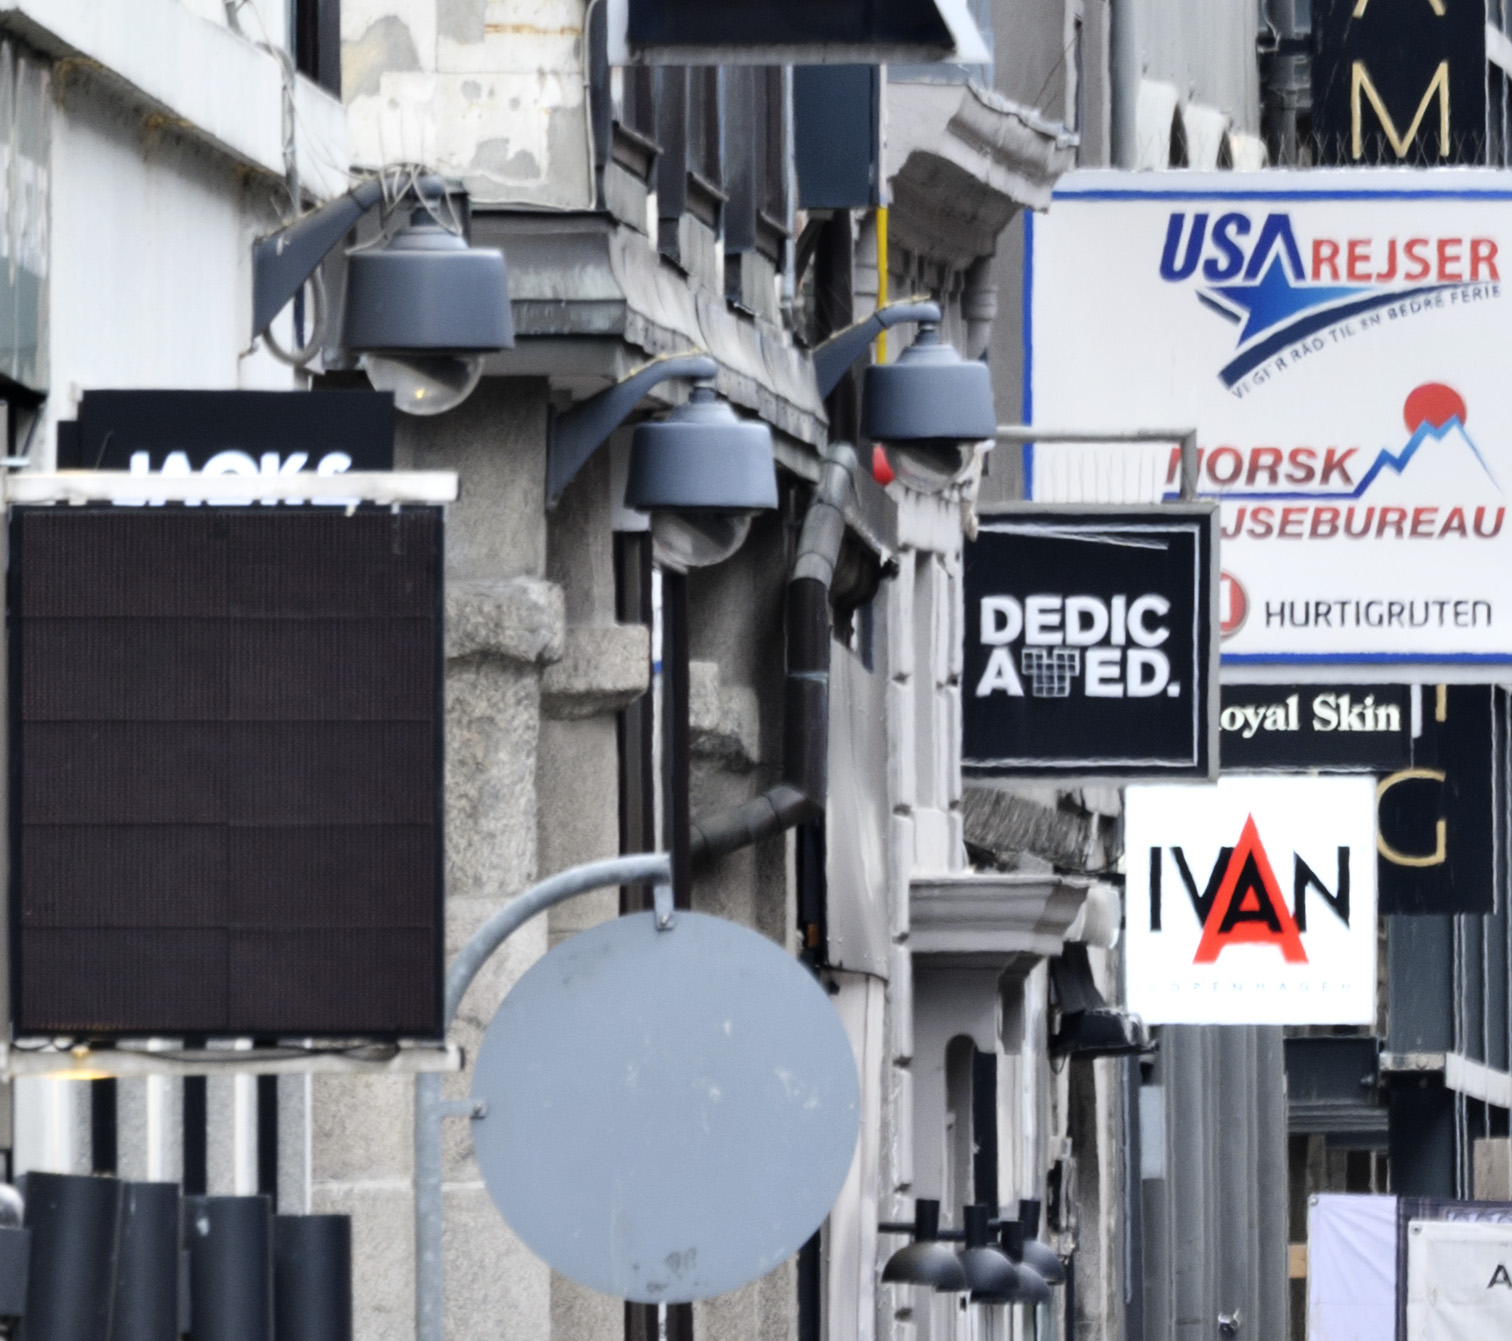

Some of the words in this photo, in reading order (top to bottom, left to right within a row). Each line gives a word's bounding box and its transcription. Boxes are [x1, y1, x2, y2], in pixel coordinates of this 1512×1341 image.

[1159, 212, 1307, 283] USA
[1311, 238, 1501, 282] REJSER
[1329, 325, 1356, 345] TIL
[1388, 295, 1444, 322] BEDRE
[1451, 284, 1502, 305] FERIE
[980, 595, 1170, 646] DEDIC
[1264, 600, 1492, 629] HURTIGRUTEN
[1218, 694, 1300, 738] oyal
[1311, 693, 1402, 734] Skin
[1150, 812, 1351, 964] IVAN
